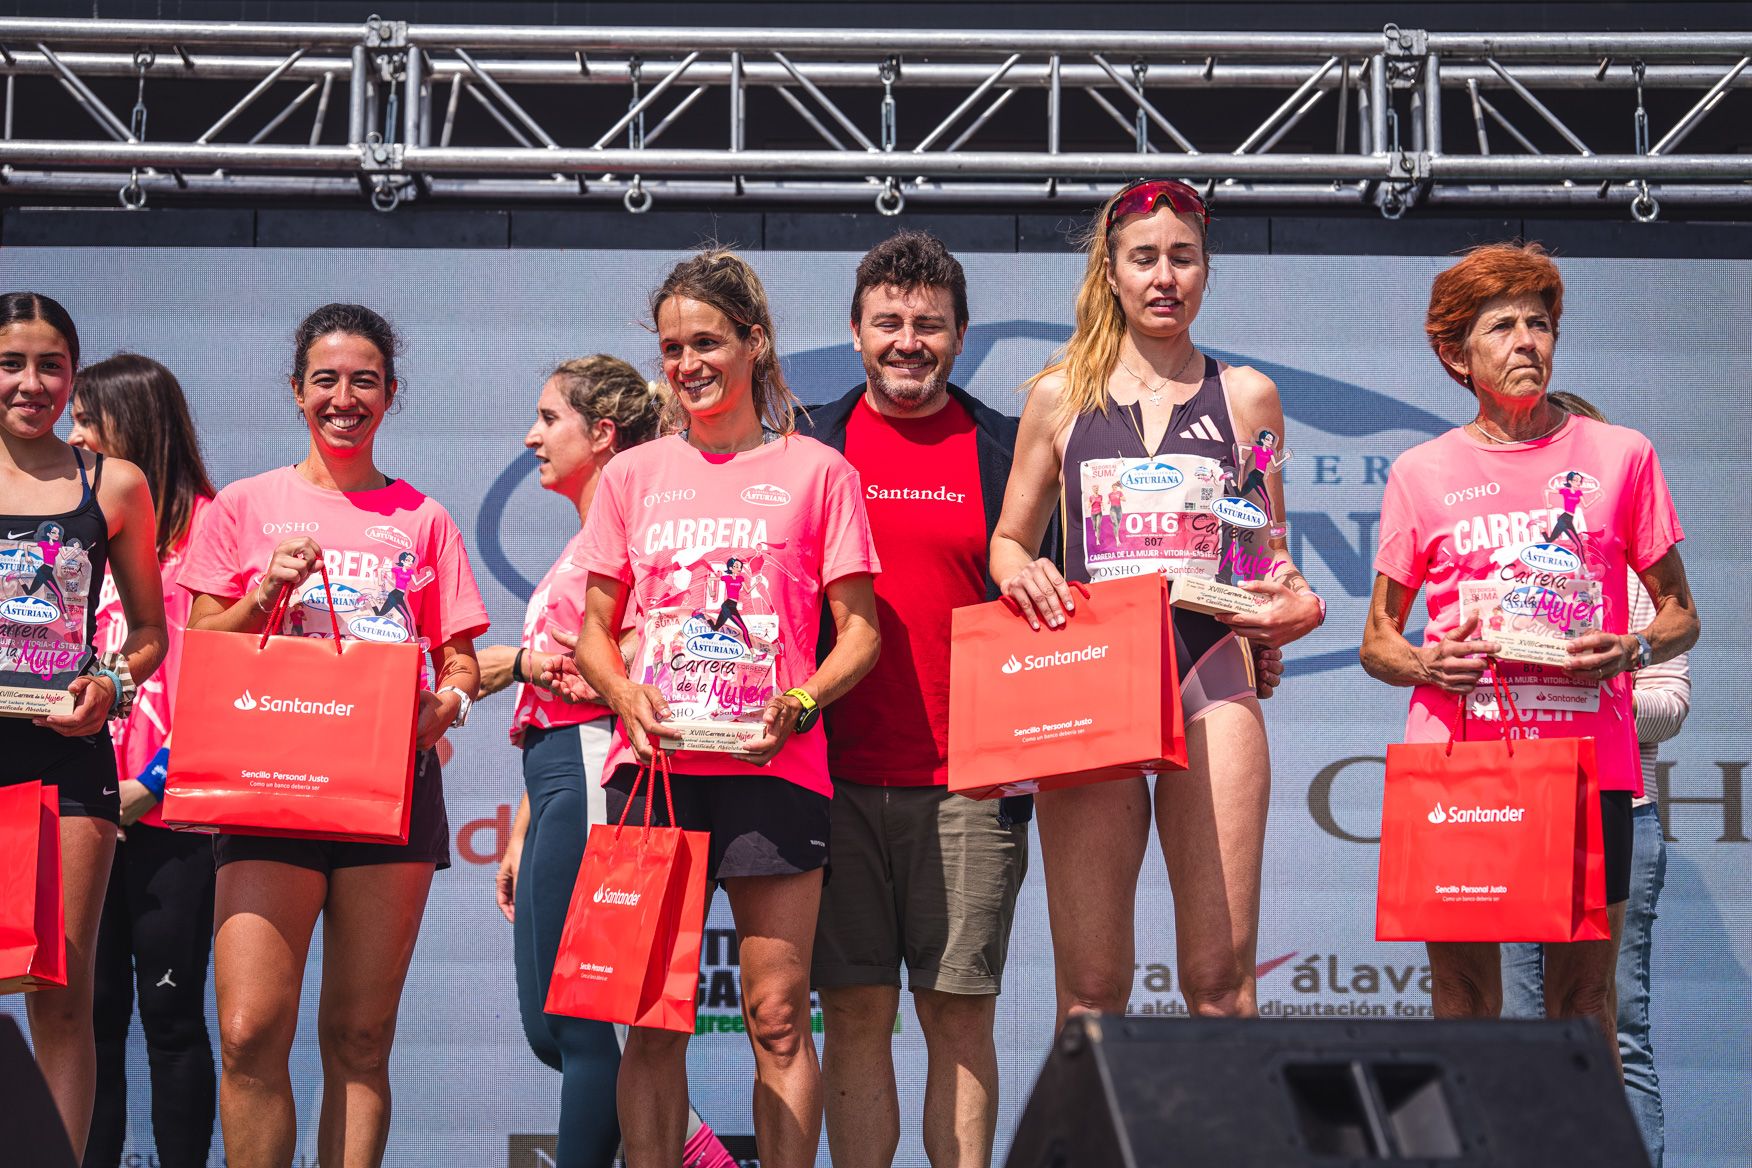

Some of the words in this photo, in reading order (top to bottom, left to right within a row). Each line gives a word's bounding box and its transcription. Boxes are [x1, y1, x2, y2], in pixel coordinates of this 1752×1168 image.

[1126, 474, 1180, 484] ASTURIANA
[644, 489, 696, 508] OYSHO
[745, 490, 787, 503] ASTURIANA
[866, 484, 966, 503] Santander
[1444, 482, 1500, 506] OYSHO
[1216, 502, 1261, 525] ASTURIANA
[263, 522, 319, 534] OYSHO
[1126, 513, 1179, 533] 016
[645, 518, 768, 554] CARRERA
[1144, 538, 1163, 546] 807
[1195, 535, 1210, 552] de
[1090, 552, 1117, 561] CARRERA
[1218, 541, 1287, 581] Mujer
[1527, 550, 1574, 568] ASTURIANA
[1100, 565, 1140, 577] OYSHO
[1500, 563, 1567, 590] Carrera
[4, 604, 53, 619] ASTURIANA
[1505, 586, 1519, 603] de
[1525, 587, 1535, 604] la
[1531, 589, 1604, 632] Mujer
[0, 623, 48, 640] arrera
[355, 622, 401, 639] ASTURIANA
[691, 641, 739, 655] ASTURIANA
[14, 639, 87, 681] Mujer
[671, 653, 735, 674] Carrera
[1024, 645, 1108, 670] Santander
[677, 676, 692, 692] de
[696, 677, 707, 693] la
[705, 675, 774, 716] Mujer
[1548, 693, 1588, 703] Santander
[260, 696, 354, 716] Santander
[735, 731, 756, 742] Mujer
[1014, 726, 1040, 737] Sencillo
[1042, 721, 1072, 731] Personal
[1074, 718, 1093, 727] Justo
[241, 770, 271, 779] Sencillo
[273, 772, 307, 781] Personal
[308, 774, 329, 783] Justo
[1448, 805, 1525, 823] Santander
[602, 888, 641, 906] Santander
[1260, 1000, 1387, 1017] diputación
